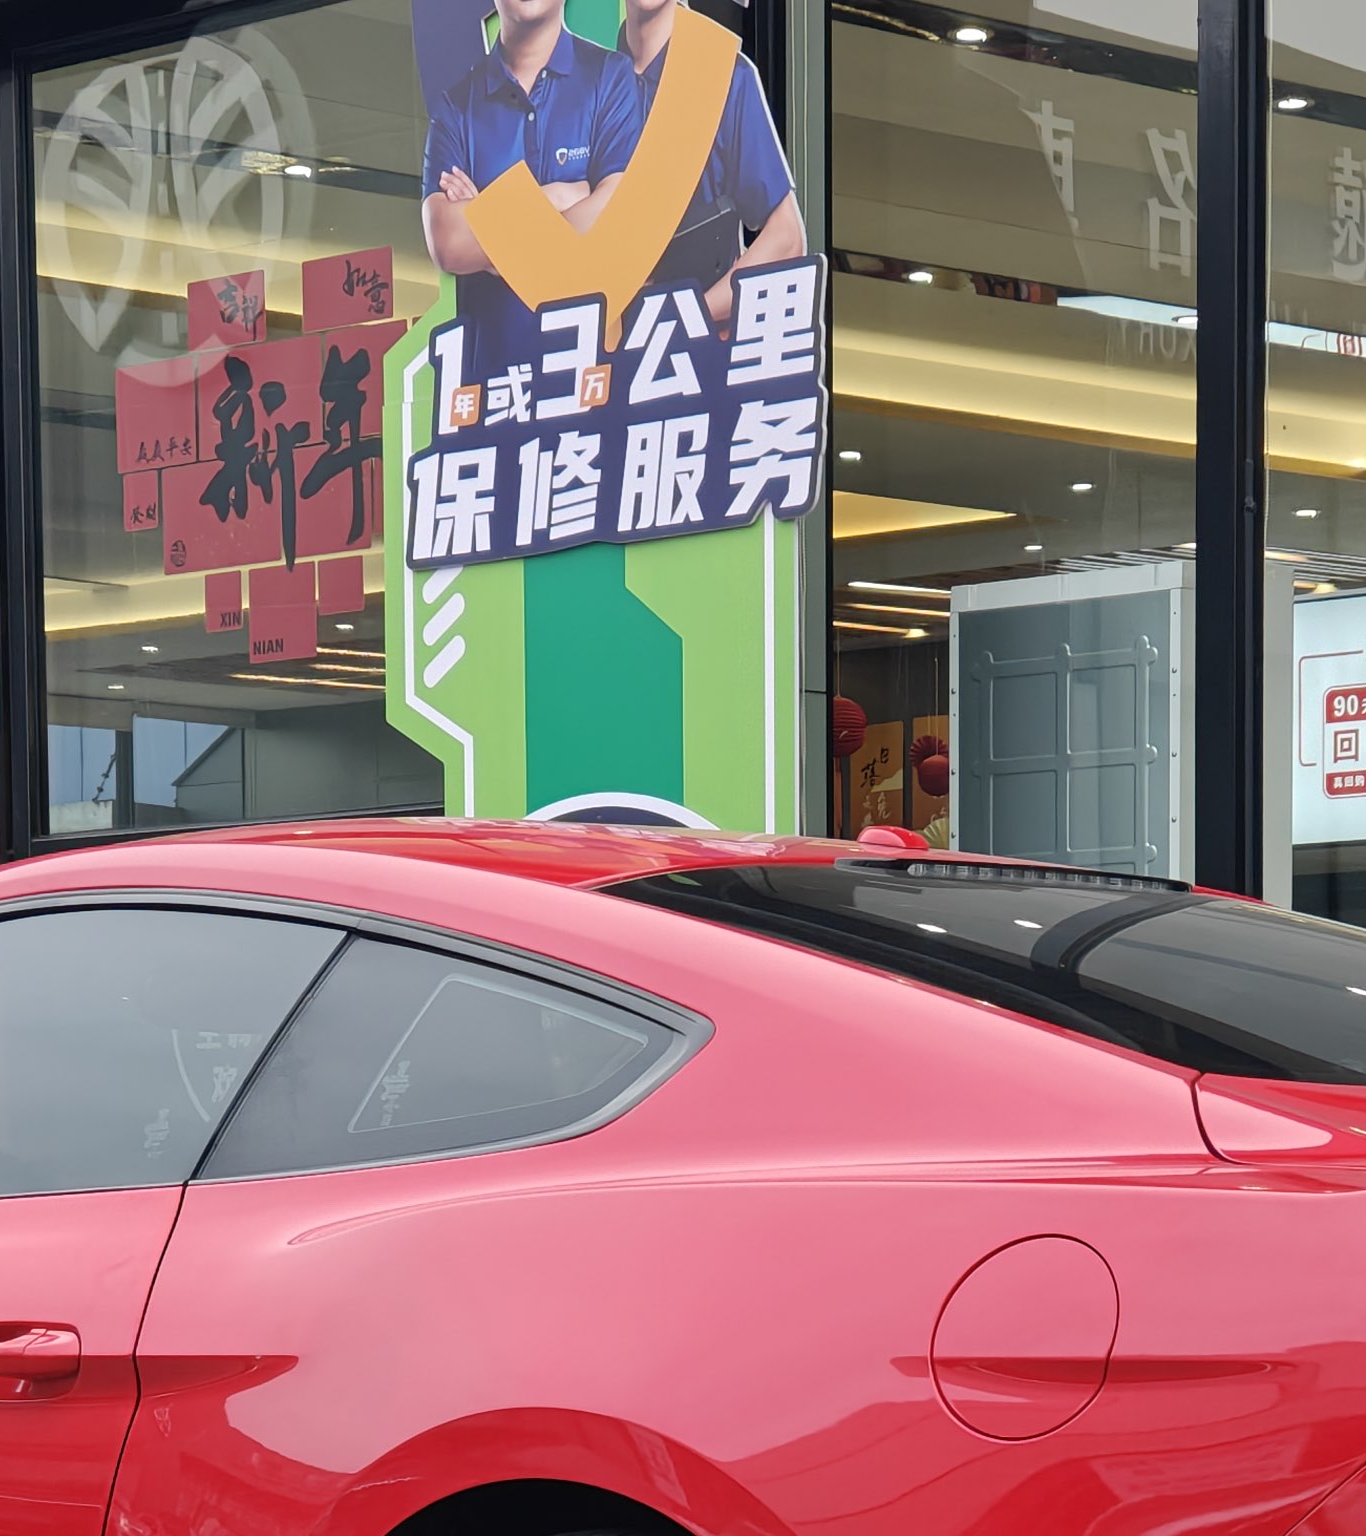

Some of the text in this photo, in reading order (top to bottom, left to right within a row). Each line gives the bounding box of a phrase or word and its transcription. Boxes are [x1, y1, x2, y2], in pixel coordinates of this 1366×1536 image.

[199, 345, 383, 572] 新年
[411, 396, 818, 560] 保修服务
[219, 609, 242, 628] XIN
[252, 636, 285, 656] NIAN
